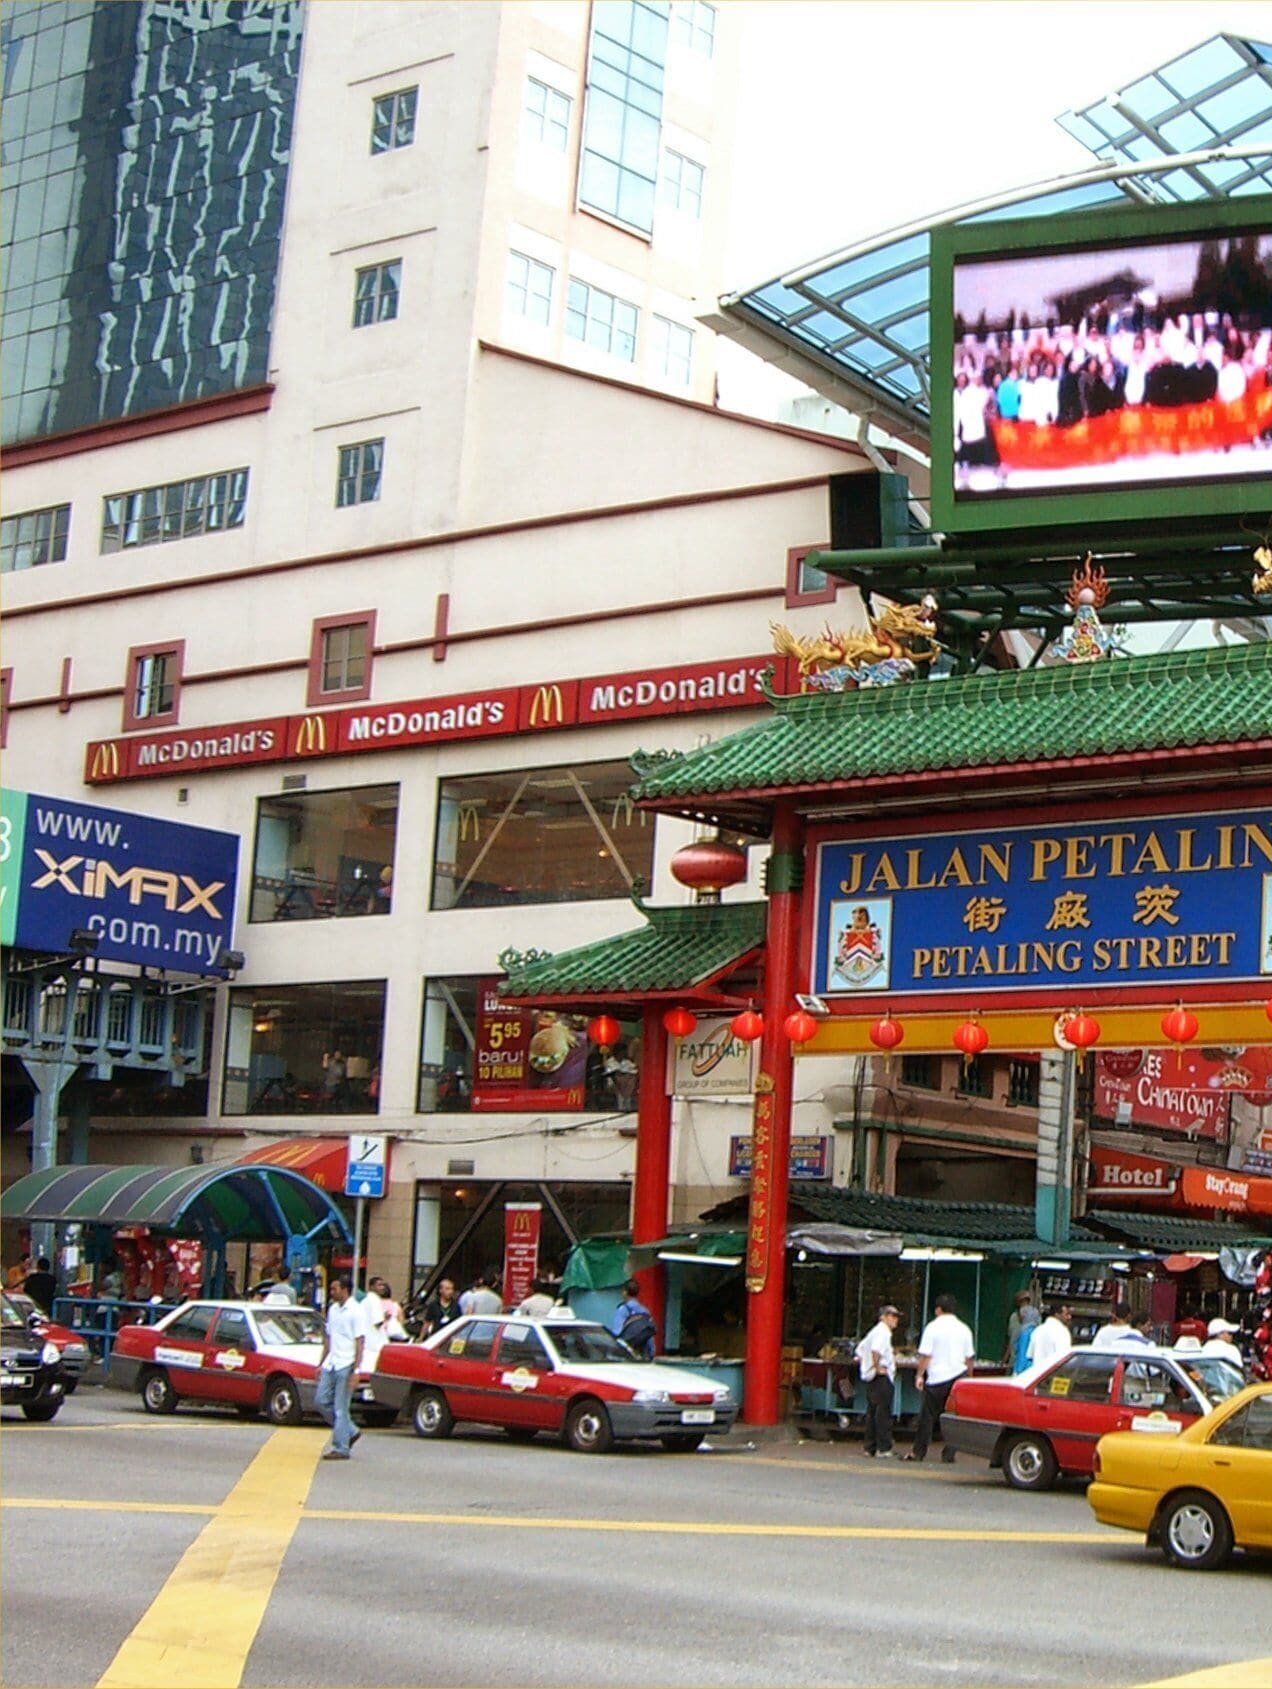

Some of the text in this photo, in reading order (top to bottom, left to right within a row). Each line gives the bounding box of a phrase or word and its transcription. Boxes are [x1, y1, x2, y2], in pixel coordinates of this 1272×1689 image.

[590, 668, 766, 712] McDonald's
[347, 701, 505, 741] McDonald's
[137, 728, 275, 767] McDonald's
[36, 807, 130, 850] www.
[839, 841, 1015, 895] JALAN
[87, 914, 222, 967] com.my
[911, 940, 1083, 979] PETALING
[1092, 932, 1237, 972] STREET
[1102, 1164, 1164, 1187] Hotel
